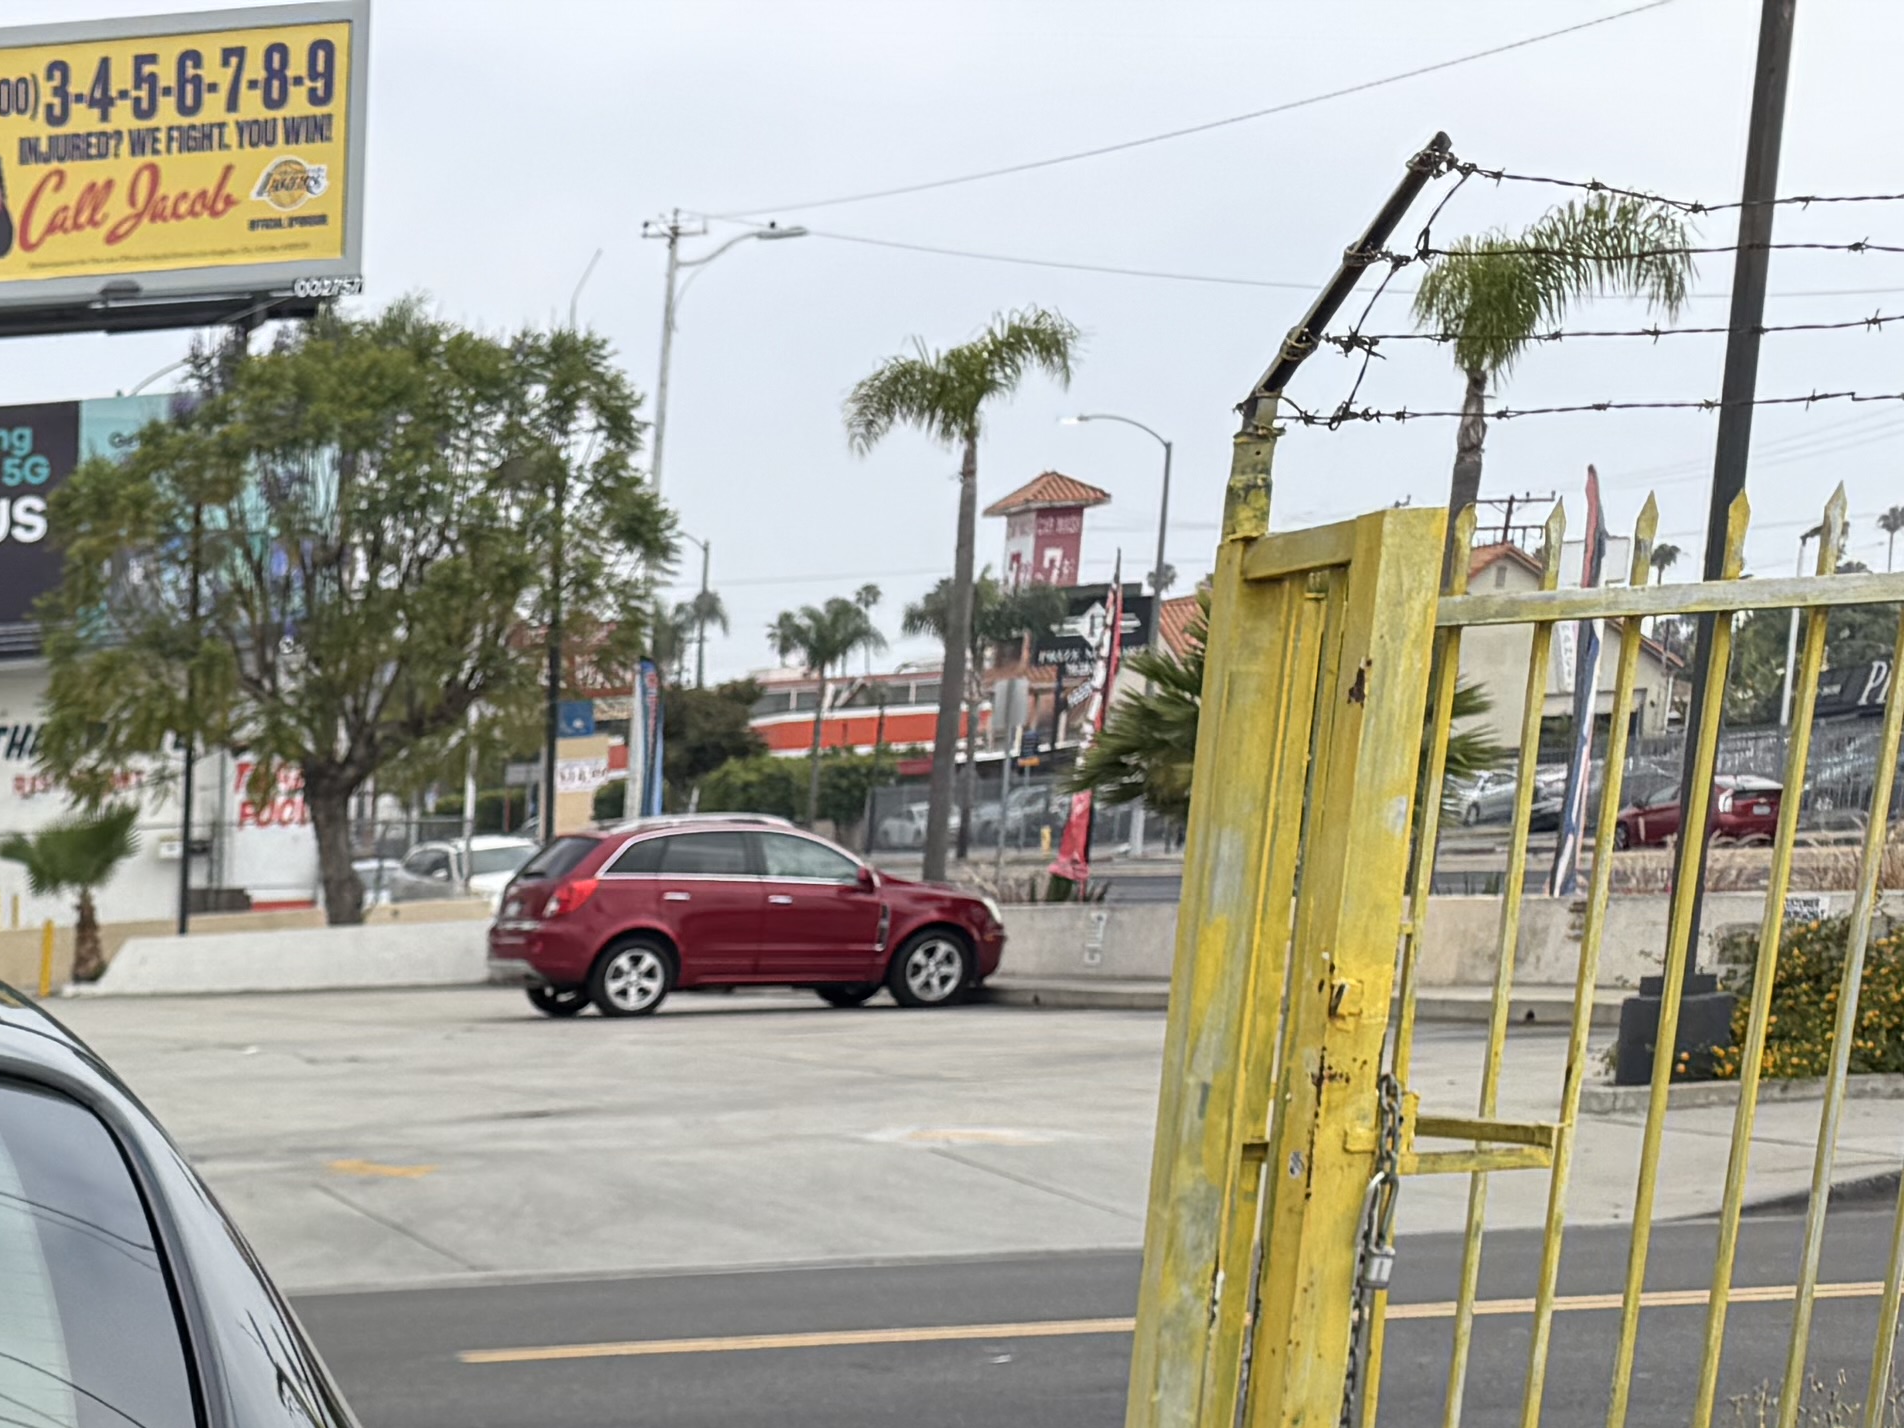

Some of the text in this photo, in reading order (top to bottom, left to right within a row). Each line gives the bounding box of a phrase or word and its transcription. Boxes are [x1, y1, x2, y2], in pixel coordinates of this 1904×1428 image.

[45, 39, 335, 127] 3-4-5-6-7-8-9
[18, 129, 123, 166] INJURED?
[128, 127, 161, 158] WE
[234, 117, 280, 150] YOU
[282, 113, 334, 146] WIN!
[18, 162, 240, 253] Call Jacob
[1, 454, 51, 487] 5G
